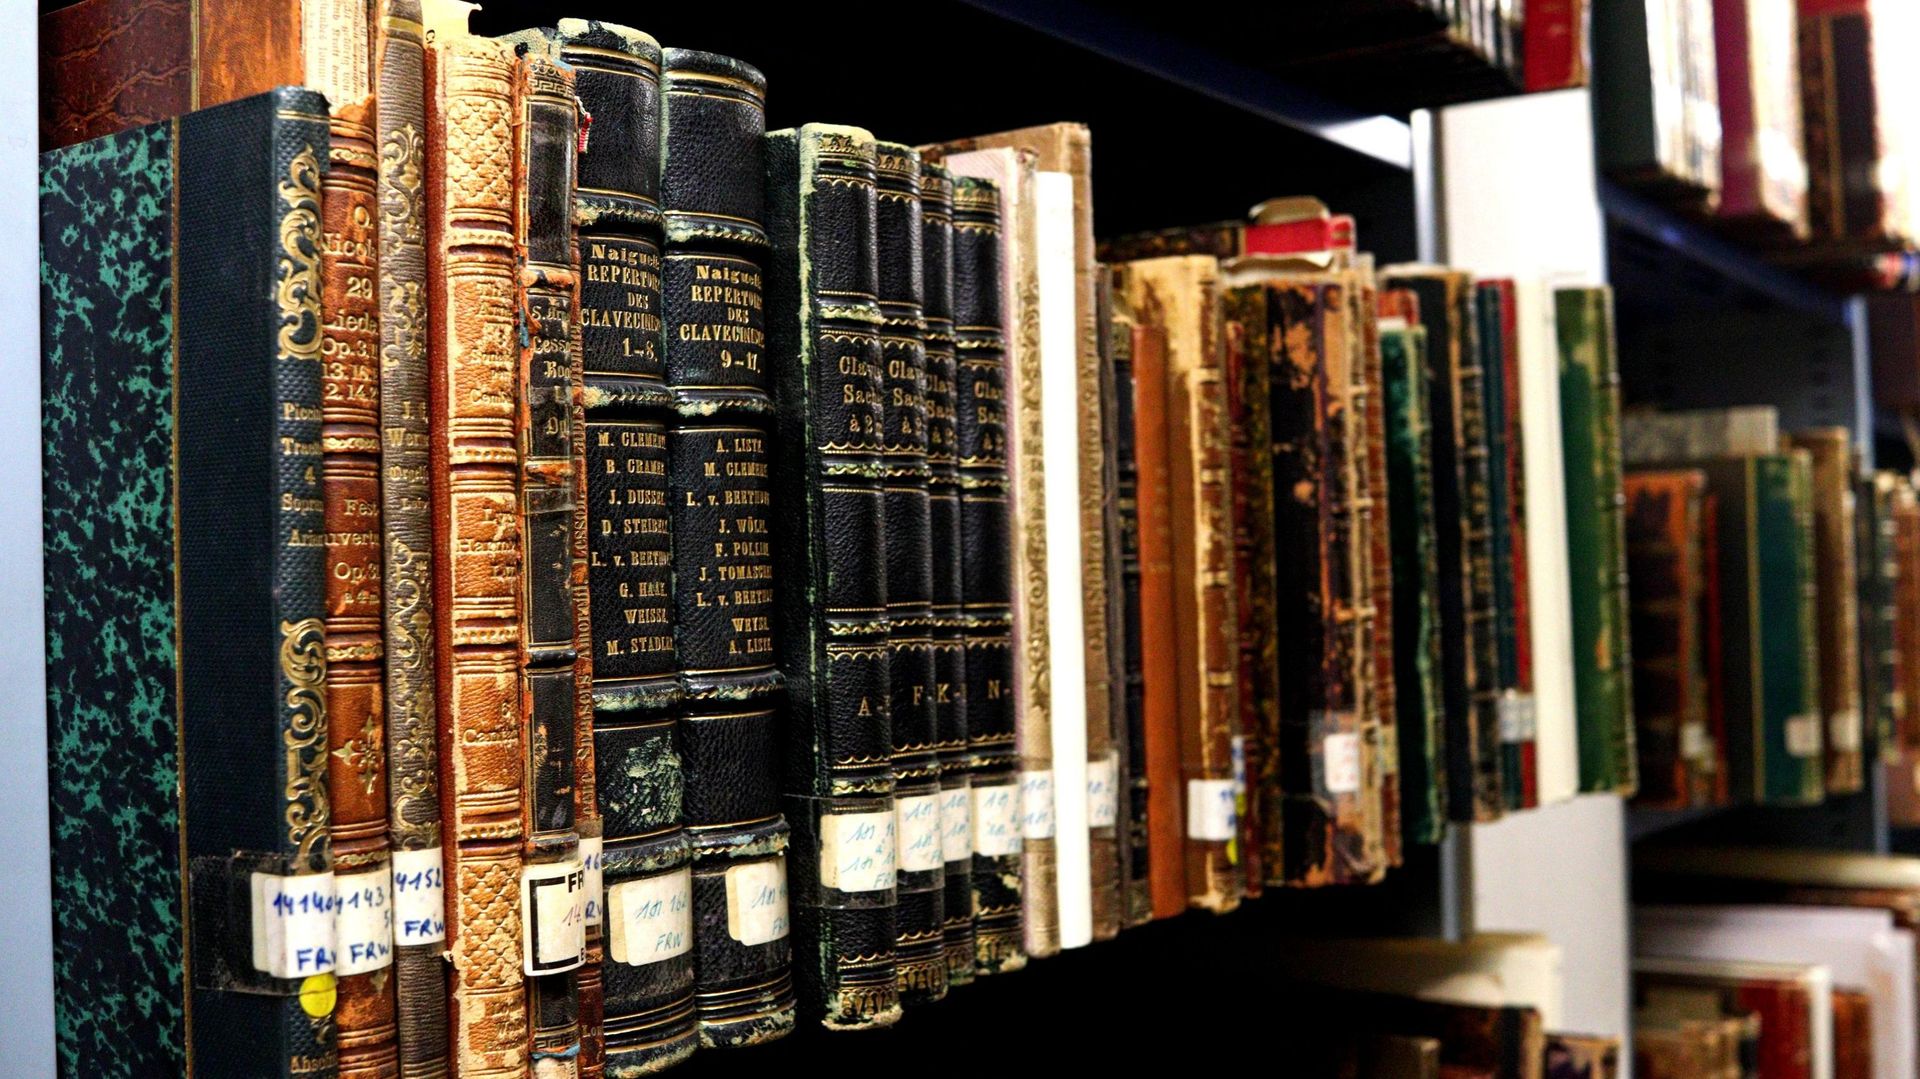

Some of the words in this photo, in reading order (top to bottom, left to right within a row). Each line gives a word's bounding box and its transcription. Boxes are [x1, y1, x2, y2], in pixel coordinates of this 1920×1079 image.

[347, 276, 373, 300] 29
[627, 292, 649, 310] DES
[728, 307, 749, 324] DES
[598, 431, 614, 446] M.
[716, 438, 729, 453] A.
[606, 459, 621, 474] B.
[704, 462, 720, 477] M.
[304, 466, 316, 485] 4
[609, 490, 621, 505] J.
[686, 492, 701, 507] L.
[601, 519, 617, 535] D.
[718, 519, 730, 534] J.
[714, 542, 728, 558] F.
[591, 551, 607, 567] L.
[699, 566, 712, 582] J.
[619, 582, 634, 598] G.
[696, 592, 711, 607] L.
[606, 640, 624, 656] M.
[729, 640, 742, 654] A.
[296, 947, 337, 971] FR
